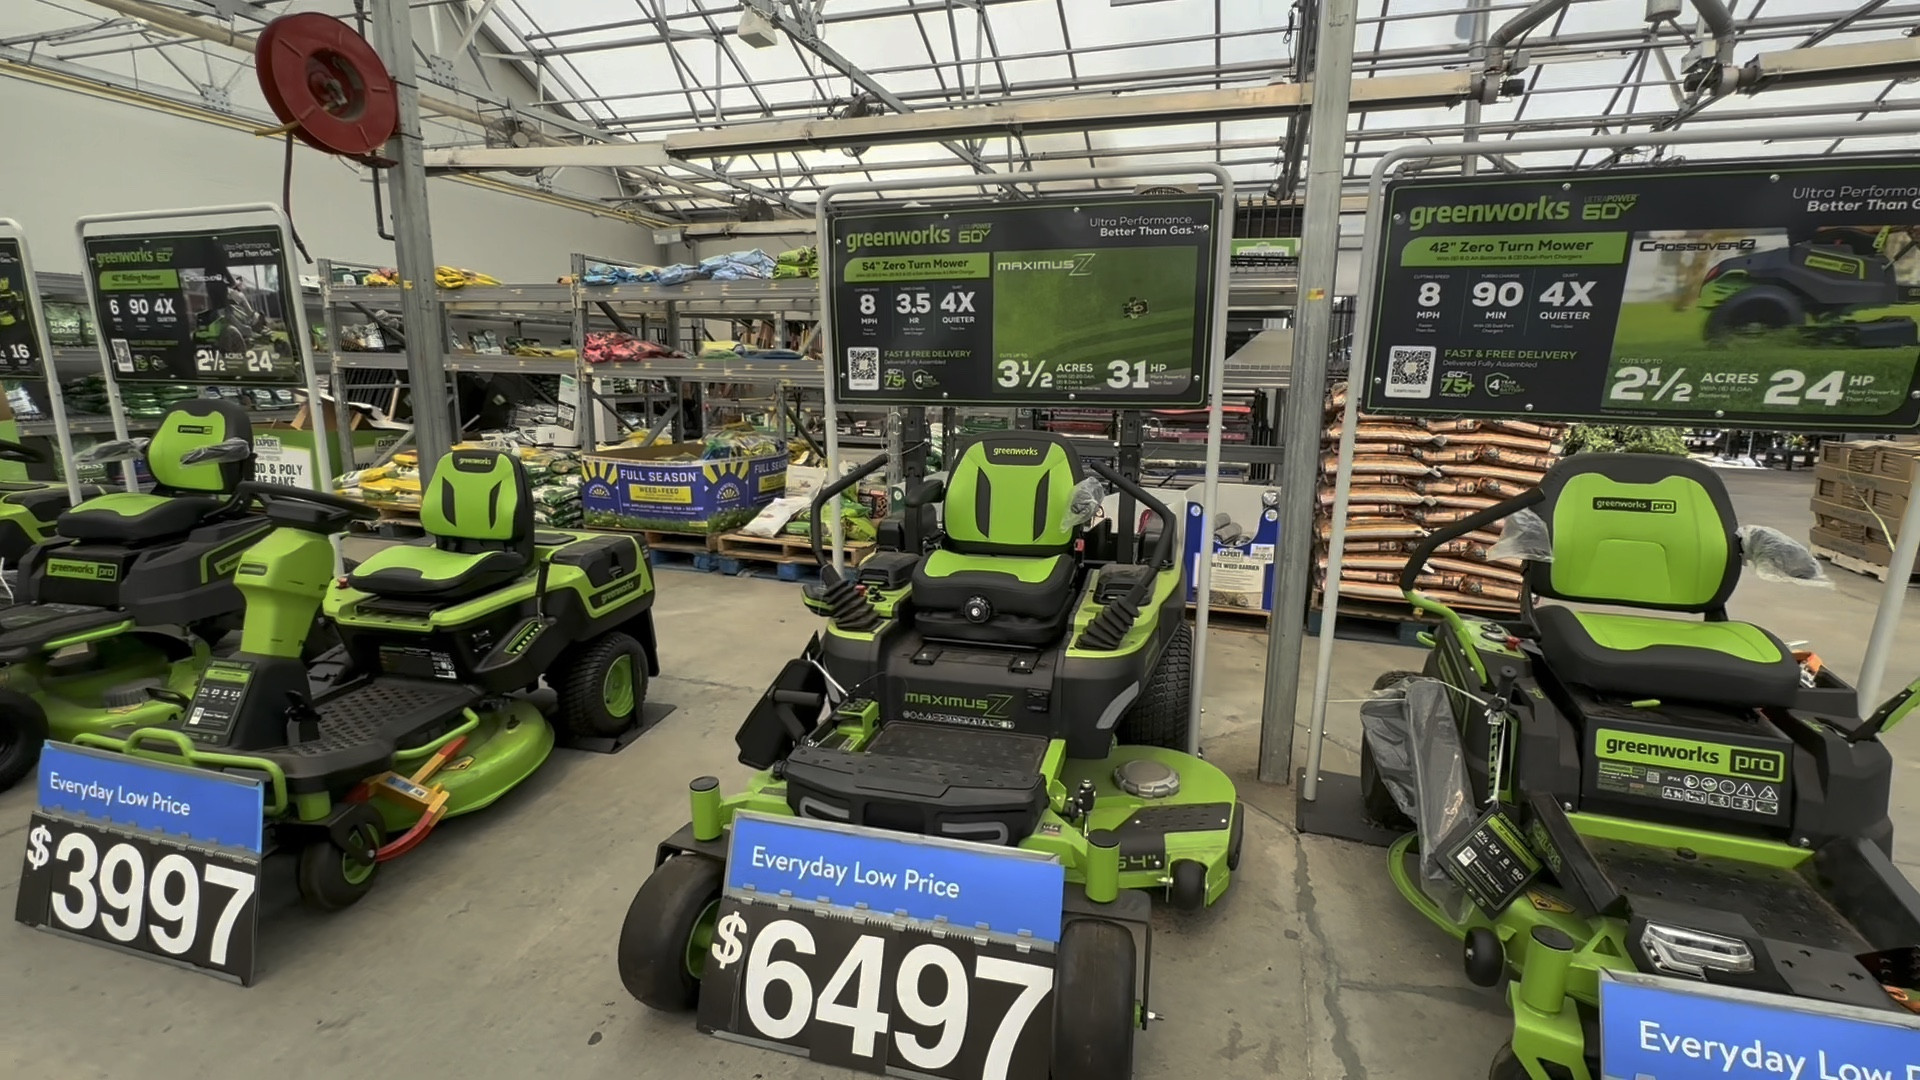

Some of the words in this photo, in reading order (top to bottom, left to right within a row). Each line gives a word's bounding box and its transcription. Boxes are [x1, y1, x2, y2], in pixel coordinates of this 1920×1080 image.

[1793, 187, 1835, 199] Ultra
[1840, 185, 1920, 198] Performa
[1409, 195, 1570, 231] greenworks
[1807, 201, 1862, 212] Better
[1867, 199, 1907, 210] Than
[1089, 217, 1117, 227] Ultra
[1119, 215, 1195, 227] Performance.
[846, 225, 950, 253] greenworks
[1100, 227, 1136, 237] Better
[1139, 226, 1167, 236] Than
[245, 249, 259, 257] Than
[1429, 242, 1457, 253] 42"
[1460, 241, 1494, 253] Zero
[1499, 240, 1534, 251] Turn
[1538, 238, 1593, 251] Mower
[95, 247, 153, 268] greenworks
[862, 261, 880, 271] 54"
[883, 260, 906, 270] Zero
[908, 259, 931, 269] Turn
[933, 258, 969, 268] Mower
[1418, 282, 1441, 307] 8
[1472, 282, 1524, 307] 90
[1539, 281, 1597, 307] 4X
[110, 299, 120, 315] 6
[129, 298, 149, 314] 90
[154, 298, 176, 314] 4X
[860, 294, 876, 315] 8
[896, 293, 931, 314] 3.5
[940, 291, 975, 313] 4X
[942, 316, 975, 324] QUIETER
[1416, 311, 1440, 319] MPH
[1485, 311, 1506, 319] MIN
[1540, 311, 1590, 320] QUIETER
[10, 344, 30, 359] 16
[1445, 350, 1473, 358] FAST
[1486, 350, 1516, 358] FREE
[1518, 350, 1577, 359] DELIVERY
[246, 350, 272, 371] 24
[1056, 363, 1093, 372] ACRES
[1150, 363, 1167, 372] HP
[1443, 359, 1476, 367] Delivered
[1478, 360, 1494, 368] Fully
[916, 375, 923, 383] 4
[1106, 359, 1149, 388] 31
[1701, 373, 1759, 384] ACRES
[1850, 375, 1875, 386] HP
[1441, 378, 1475, 393] 75+
[1489, 379, 1500, 390] 4
[1763, 369, 1846, 406] 24
[993, 447, 1038, 456] greenworks
[458, 456, 491, 466] greenworks
[269, 463, 276, 474] &
[279, 464, 302, 476] POLY
[620, 469, 645, 481] FULL
[1596, 499, 1647, 509] greenworks
[1653, 502, 1672, 513] pro
[50, 561, 95, 578] greenworks
[100, 566, 115, 578] pro
[1606, 738, 1719, 764] greenworks
[1735, 755, 1775, 772] pro
[50, 771, 113, 806] Everyday
[118, 786, 149, 808] Low
[152, 792, 191, 816] Price
[752, 846, 848, 886] Everyday
[854, 861, 897, 889] Low
[904, 869, 960, 899] Price
[27, 825, 256, 966] $3997
[711, 911, 1054, 1080] $6497
[1640, 1020, 1806, 1080] Everyday
[1819, 1049, 1892, 1080] Low
